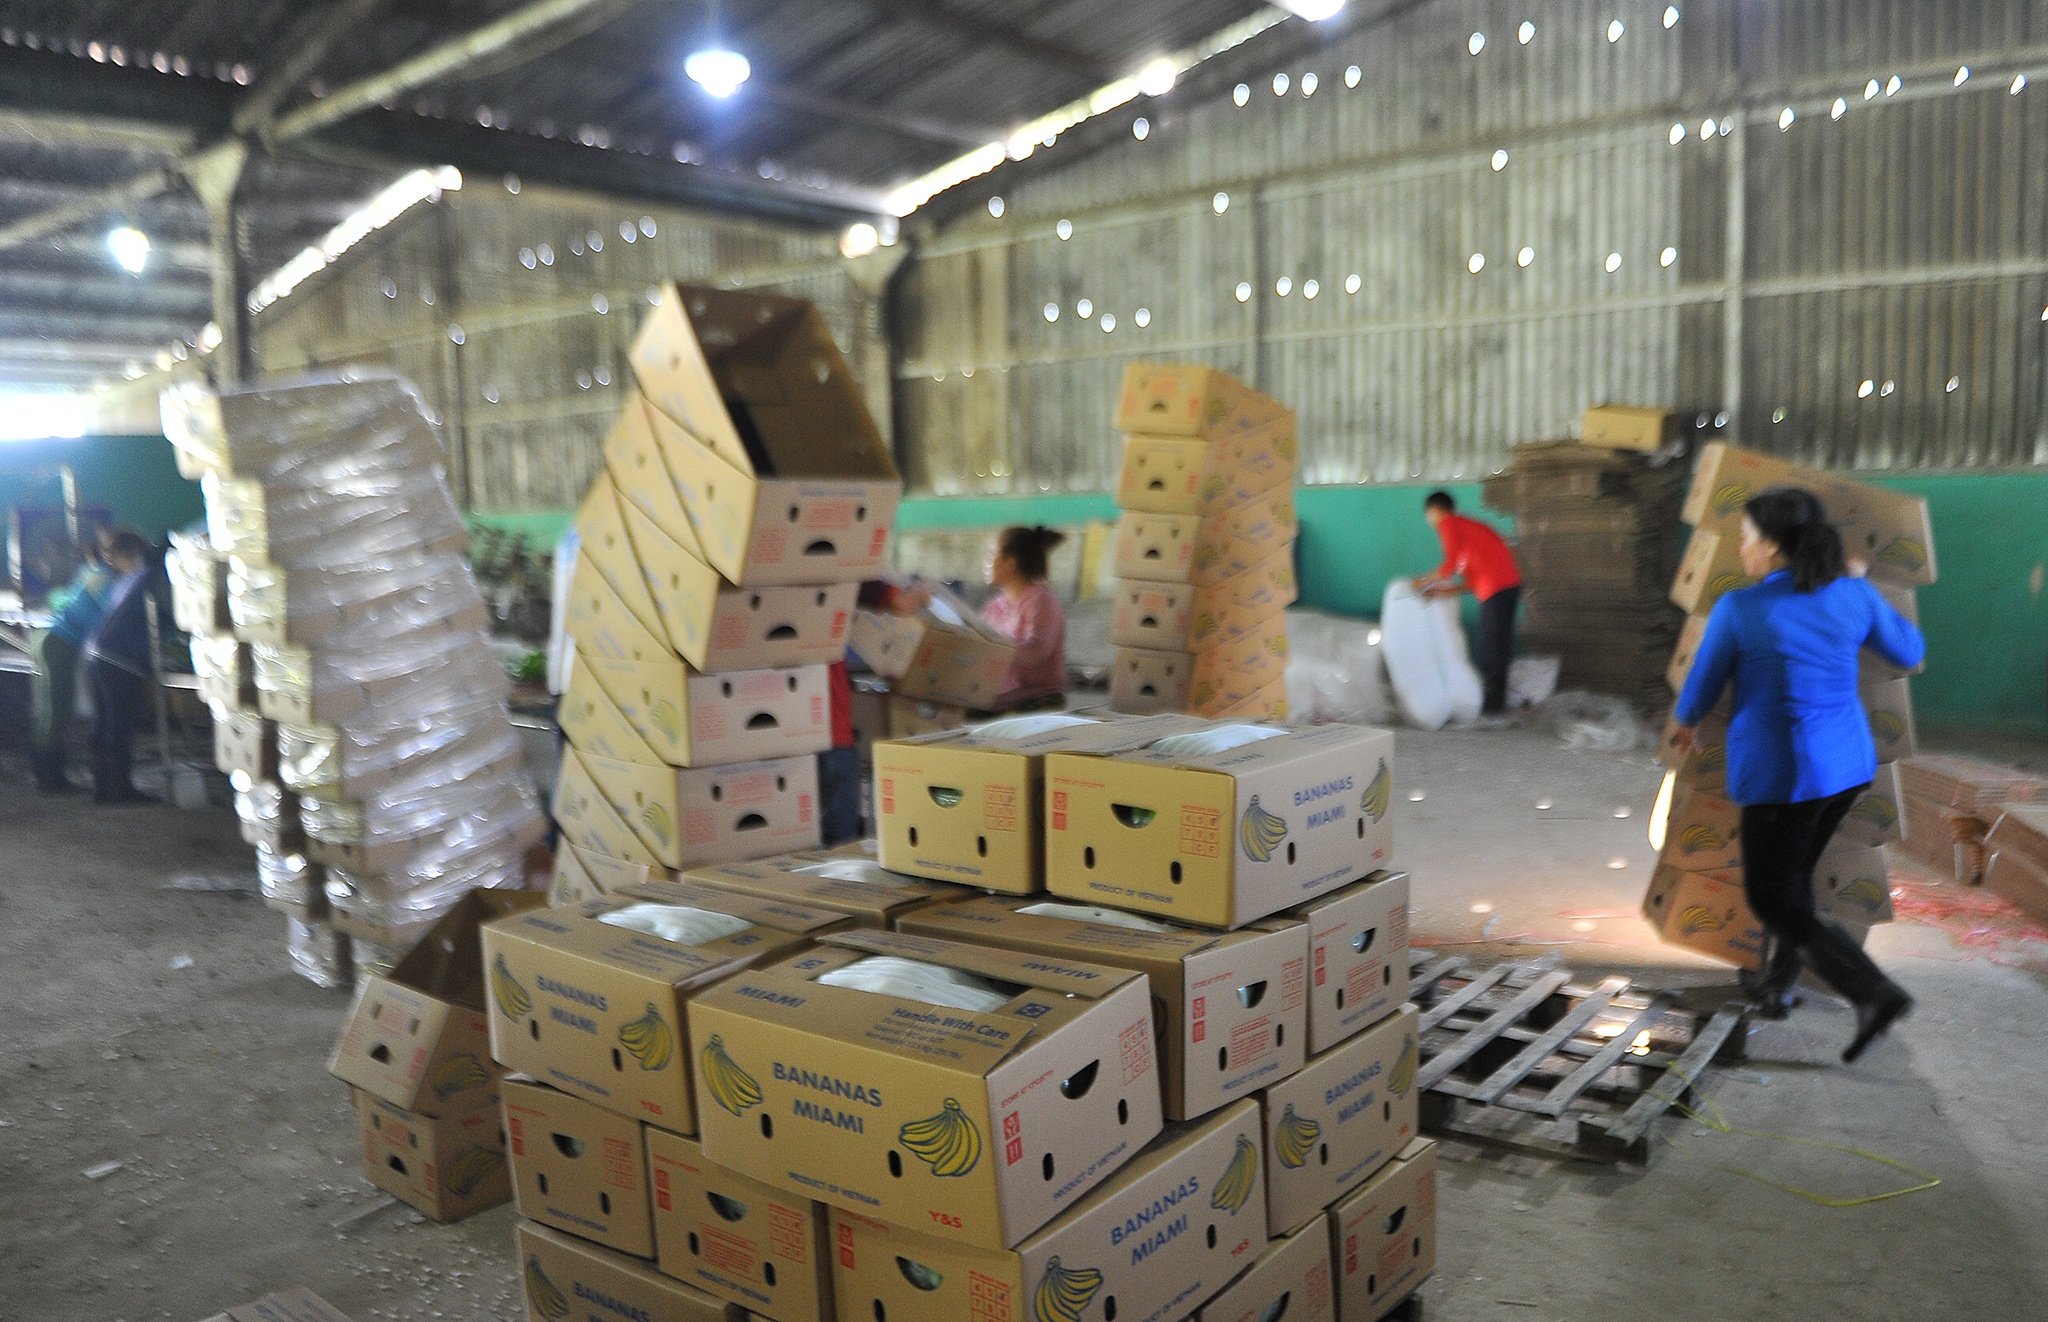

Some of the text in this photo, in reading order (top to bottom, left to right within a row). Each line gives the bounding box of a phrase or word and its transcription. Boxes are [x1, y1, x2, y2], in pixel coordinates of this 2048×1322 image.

[1294, 776, 1353, 807] BANANAS
[1306, 805, 1346, 830] MIAMI
[736, 985, 806, 1008] MIAMI
[891, 1007, 940, 1025] Handle
[942, 1017, 975, 1031] With
[977, 1025, 1010, 1040] Care
[772, 1062, 882, 1107] BANANAS
[793, 1100, 864, 1134] MIAMI
[929, 1210, 963, 1228] Y&S
[1111, 1176, 1199, 1246] BANANAS
[1131, 1214, 1189, 1266] MIAMI
